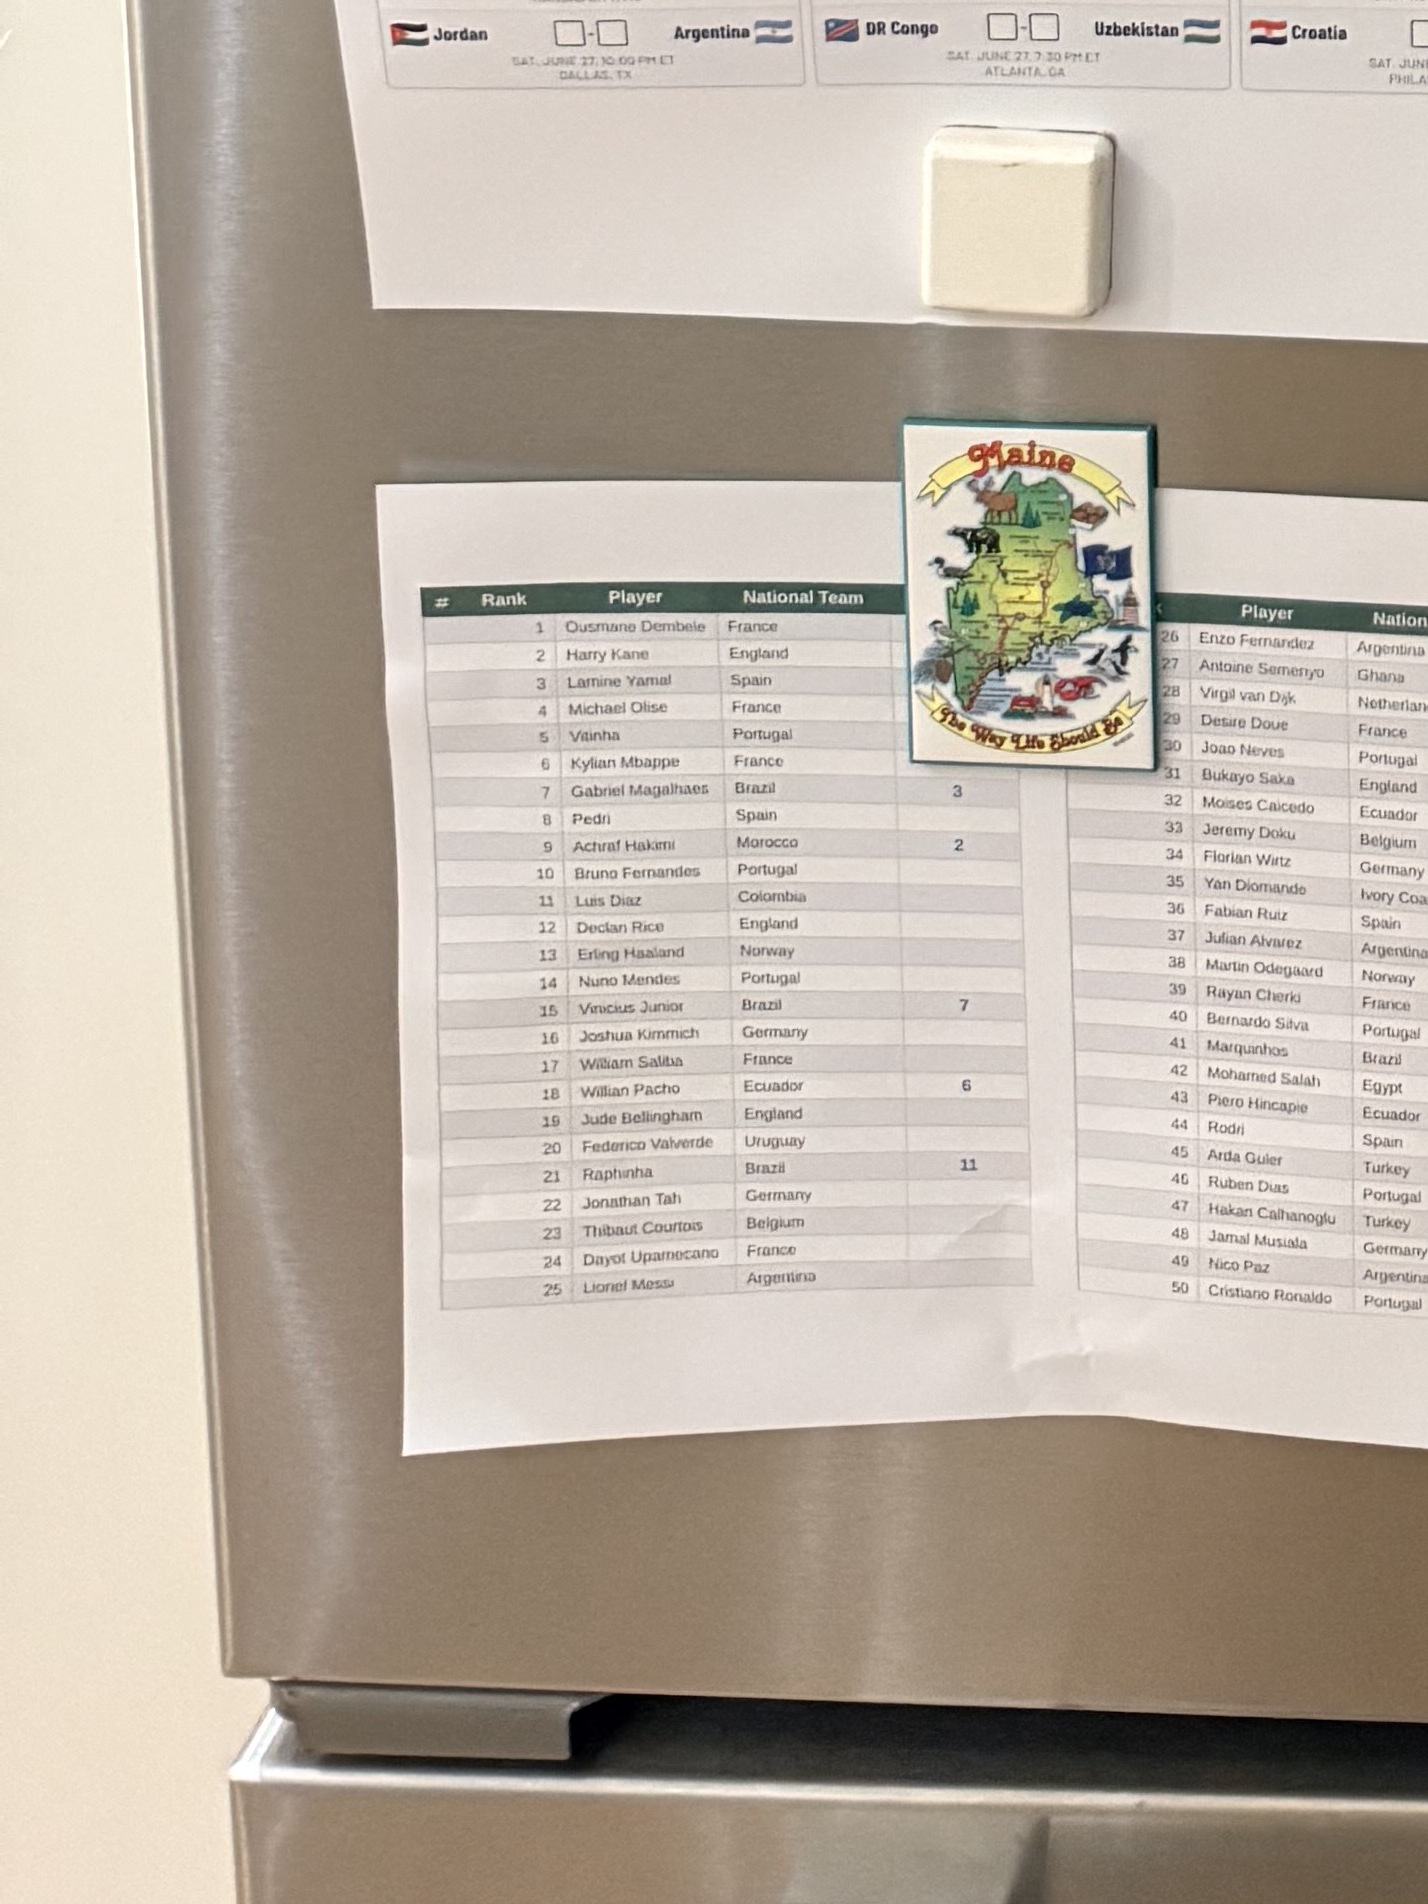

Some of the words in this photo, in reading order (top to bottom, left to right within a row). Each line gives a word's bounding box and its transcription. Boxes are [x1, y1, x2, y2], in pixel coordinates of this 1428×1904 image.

[967, 439, 1076, 479] Maine
[482, 592, 527, 606] Rank
[609, 590, 662, 607] Player
[744, 590, 813, 603] National
[818, 591, 863, 604] Team
[567, 649, 606, 663] Harry
[612, 649, 649, 660] Kane
[730, 647, 788, 662] England
[941, 707, 967, 732] The
[971, 723, 1008, 748] Way
[1011, 733, 1045, 751] Life
[1049, 725, 1100, 752] Should
[1102, 716, 1124, 736] Be
[571, 757, 616, 772] Kylian
[621, 756, 679, 770] Mbappe
[735, 755, 783, 767] France
[1203, 823, 1255, 840] Jeremy
[1259, 826, 1295, 840] Doku
[1360, 833, 1416, 851] Belgium
